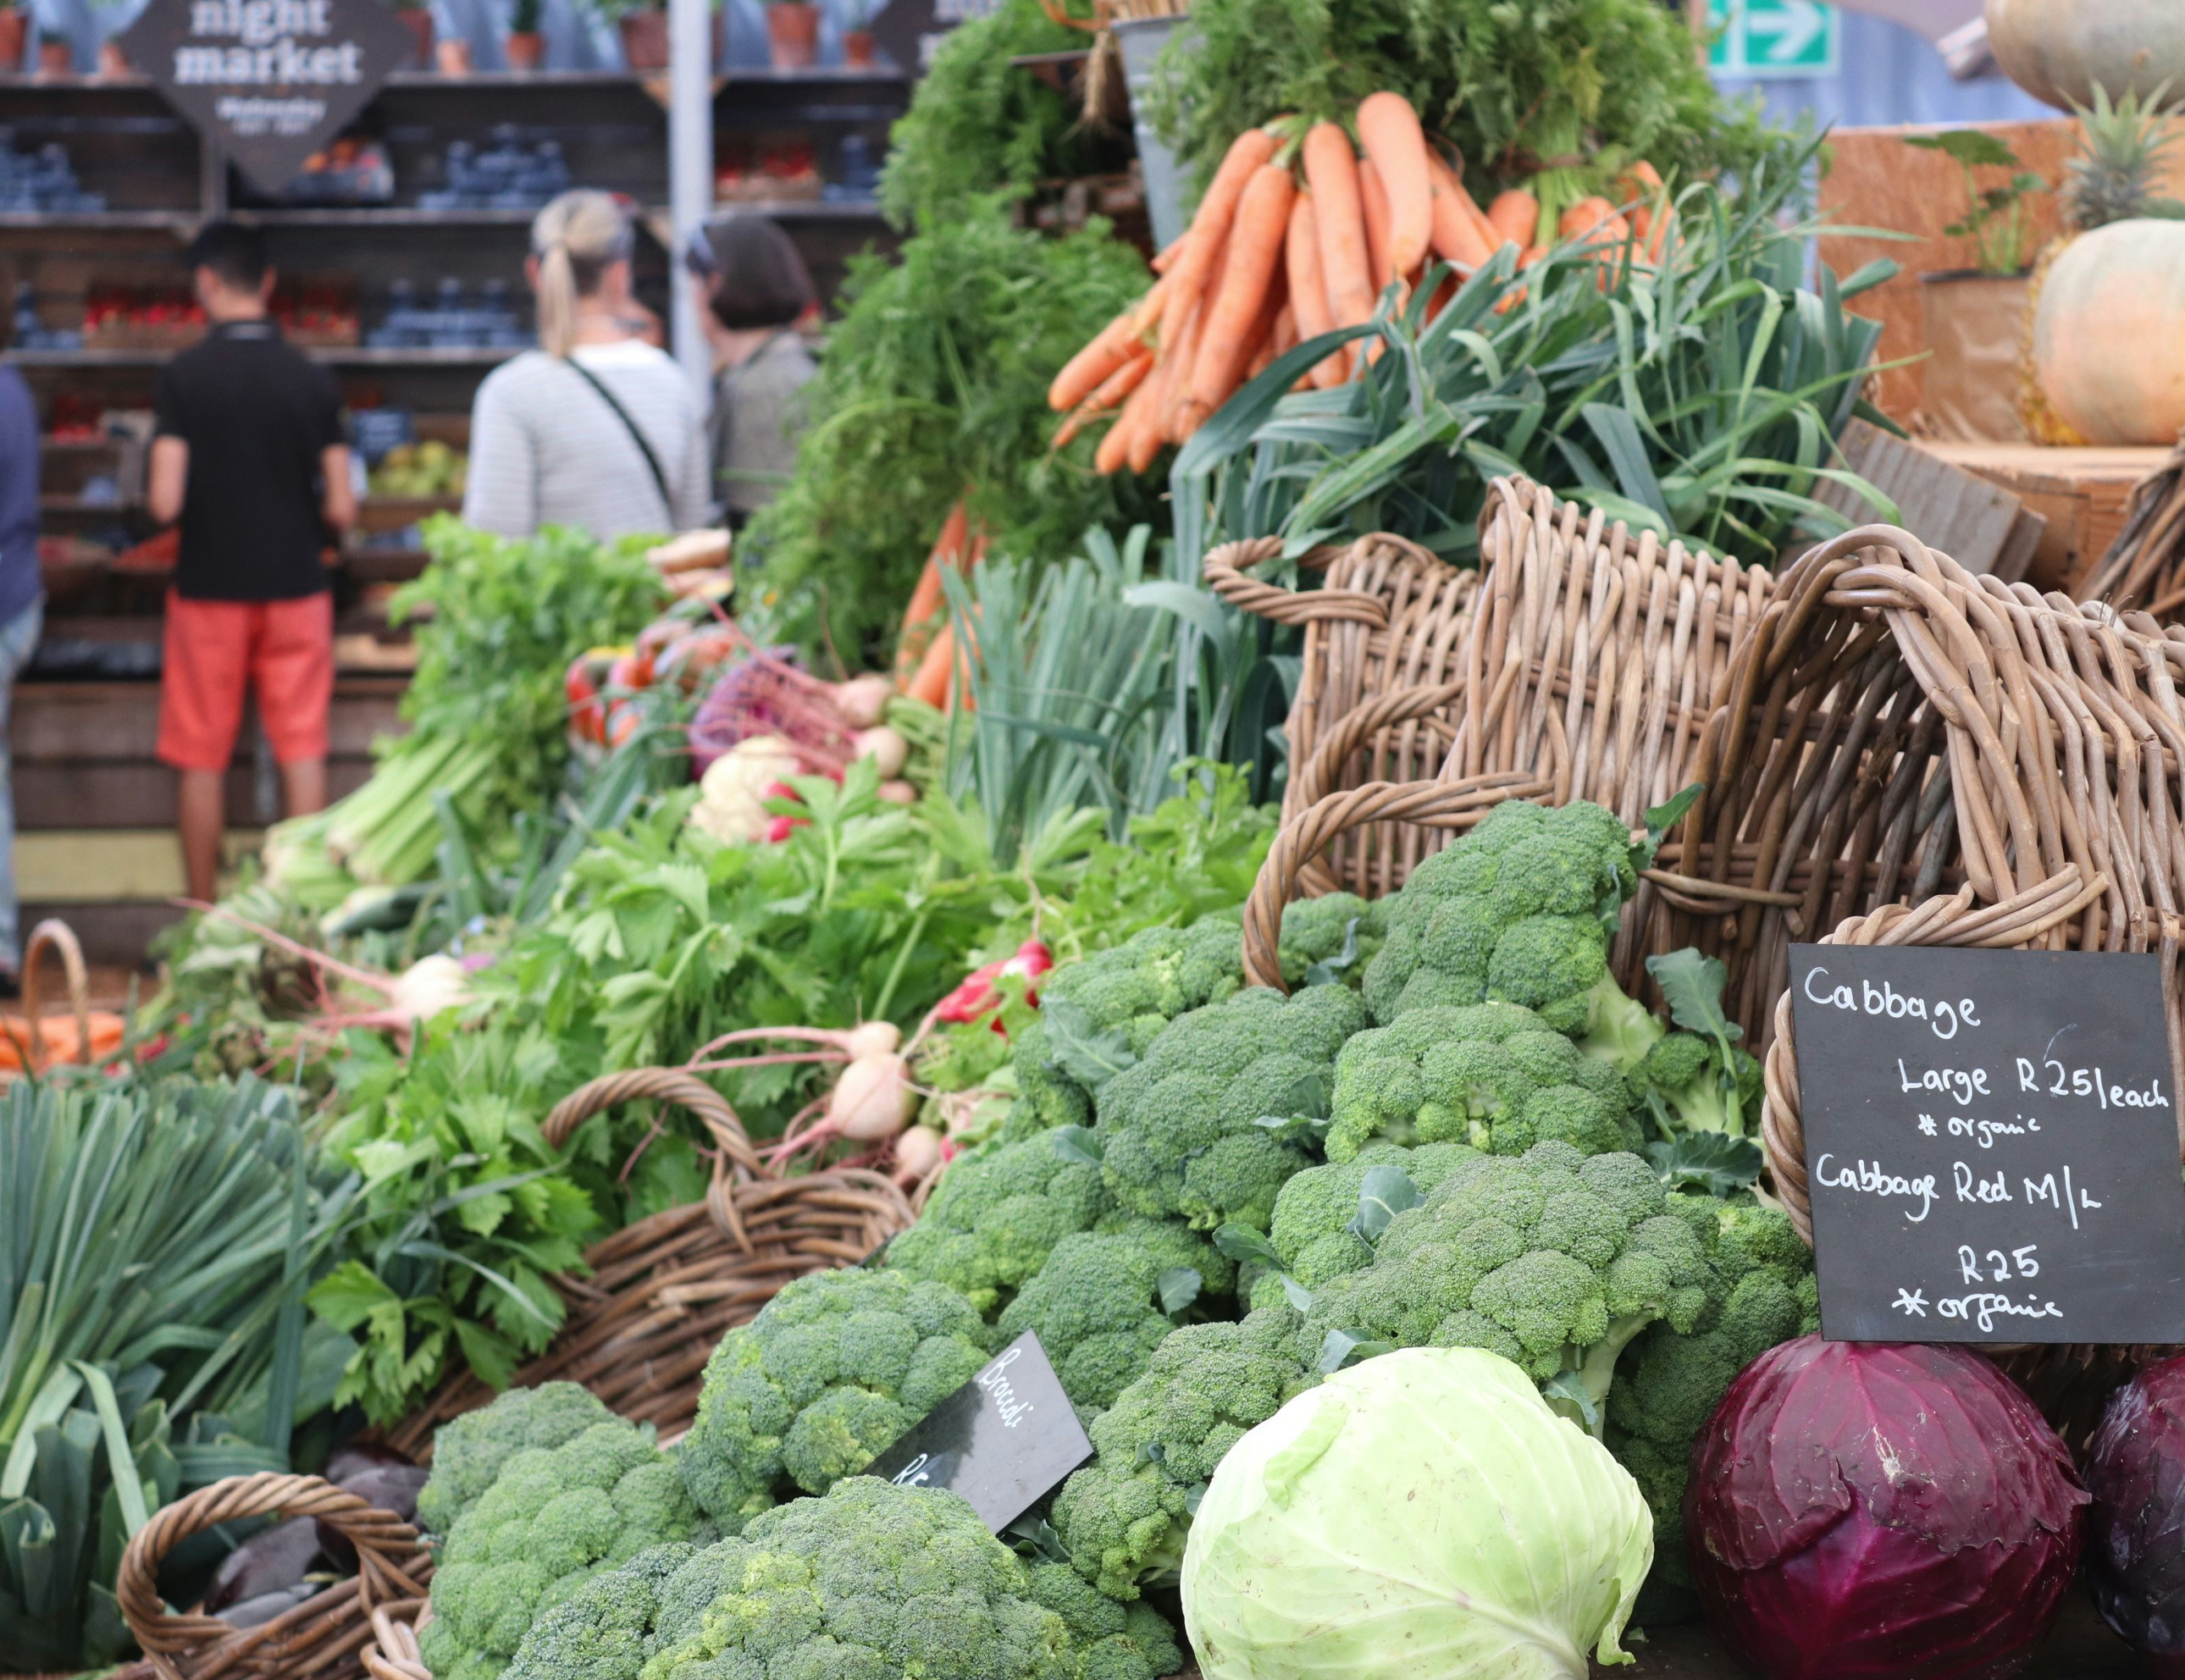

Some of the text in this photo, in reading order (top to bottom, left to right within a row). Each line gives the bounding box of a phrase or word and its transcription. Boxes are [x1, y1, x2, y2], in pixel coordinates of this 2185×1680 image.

[190, 0, 332, 46] night
[173, 37, 364, 85] market
[1805, 966, 1980, 1039] Cabbage
[1898, 1058, 1990, 1105] Large
[1816, 1152, 1939, 1223] Cabbage
[1953, 1161, 2013, 1204] Red
[1958, 1244, 2040, 1285] R25
